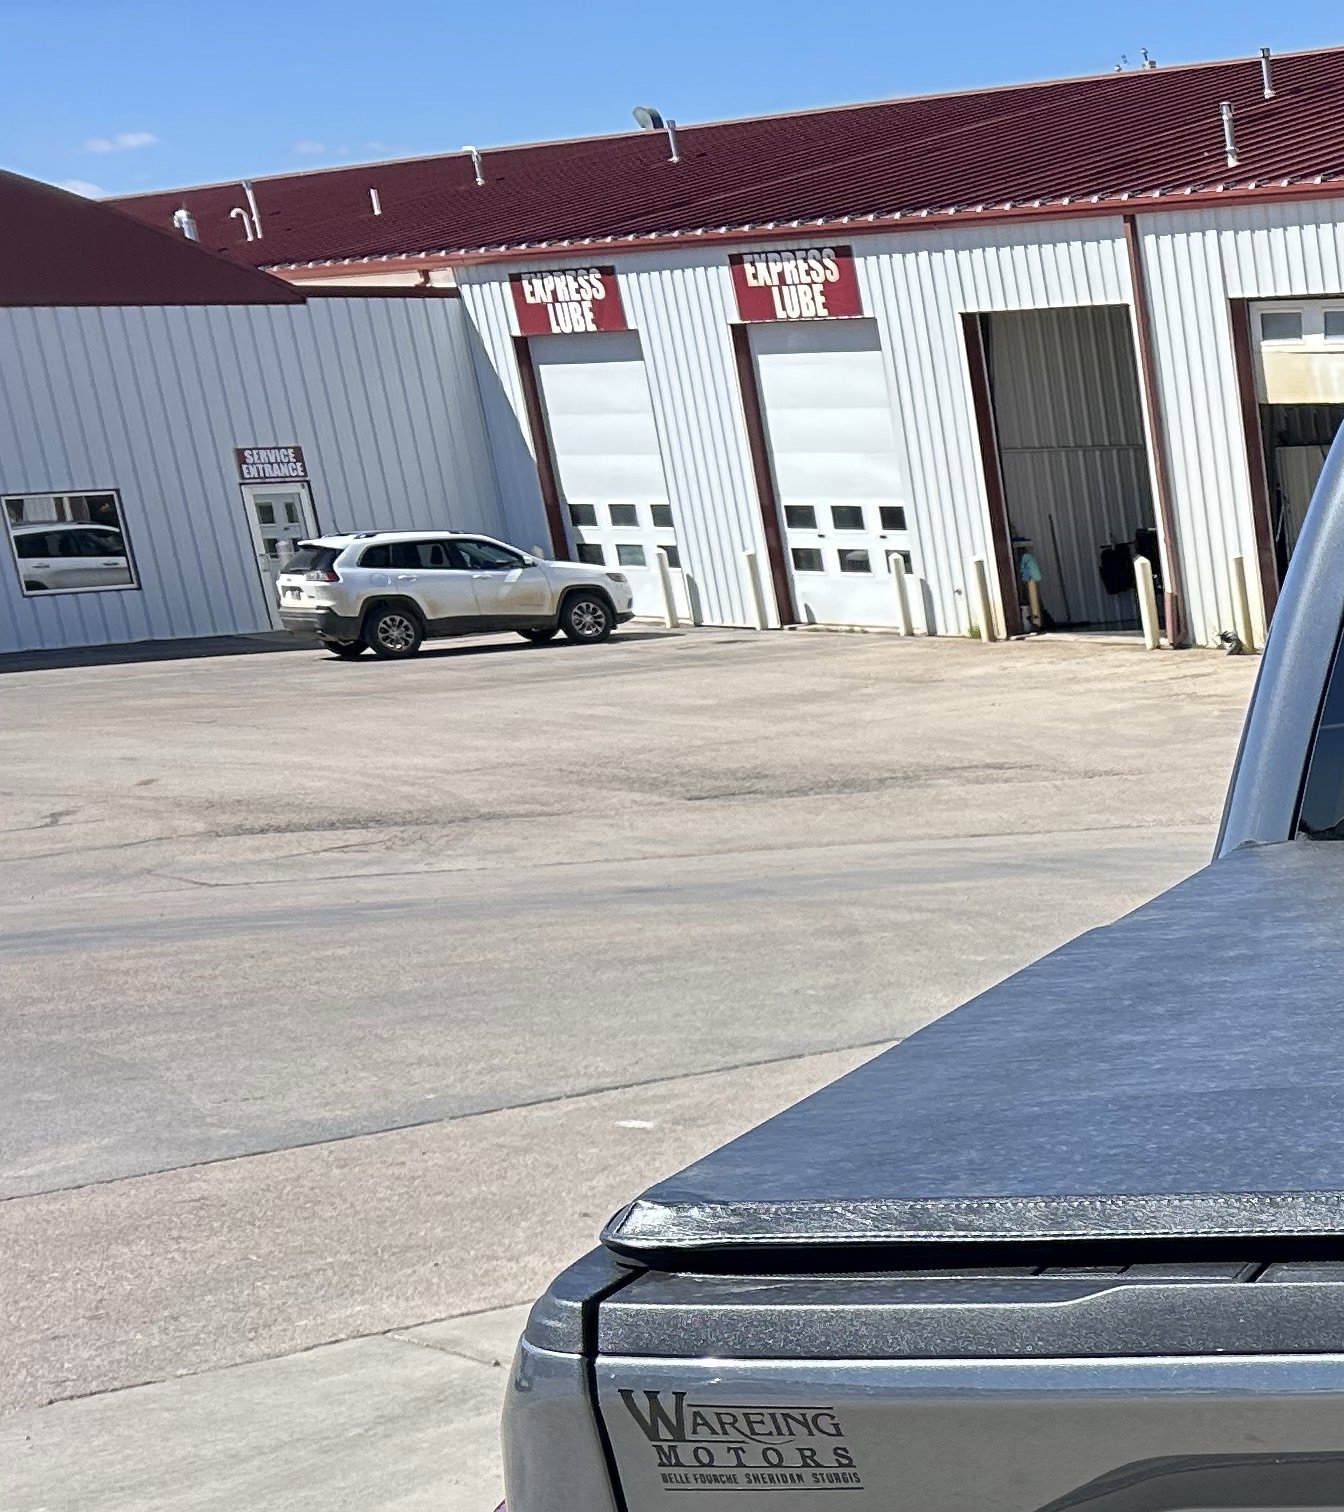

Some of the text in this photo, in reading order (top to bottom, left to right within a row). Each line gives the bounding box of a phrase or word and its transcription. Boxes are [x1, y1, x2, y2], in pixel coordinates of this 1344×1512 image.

[742, 248, 840, 287] EXPRESS
[520, 268, 606, 304] EXPRESS
[771, 283, 829, 319] LUBE
[544, 300, 598, 334] LUBE
[241, 462, 305, 478] ENTRANCE
[244, 448, 297, 464] SERVICE
[617, 1388, 845, 1446] WAREING
[651, 1444, 857, 1468] MOTORS
[660, 1472, 861, 1485] BELLE FOURCHE SHERIDAN STURGIS
